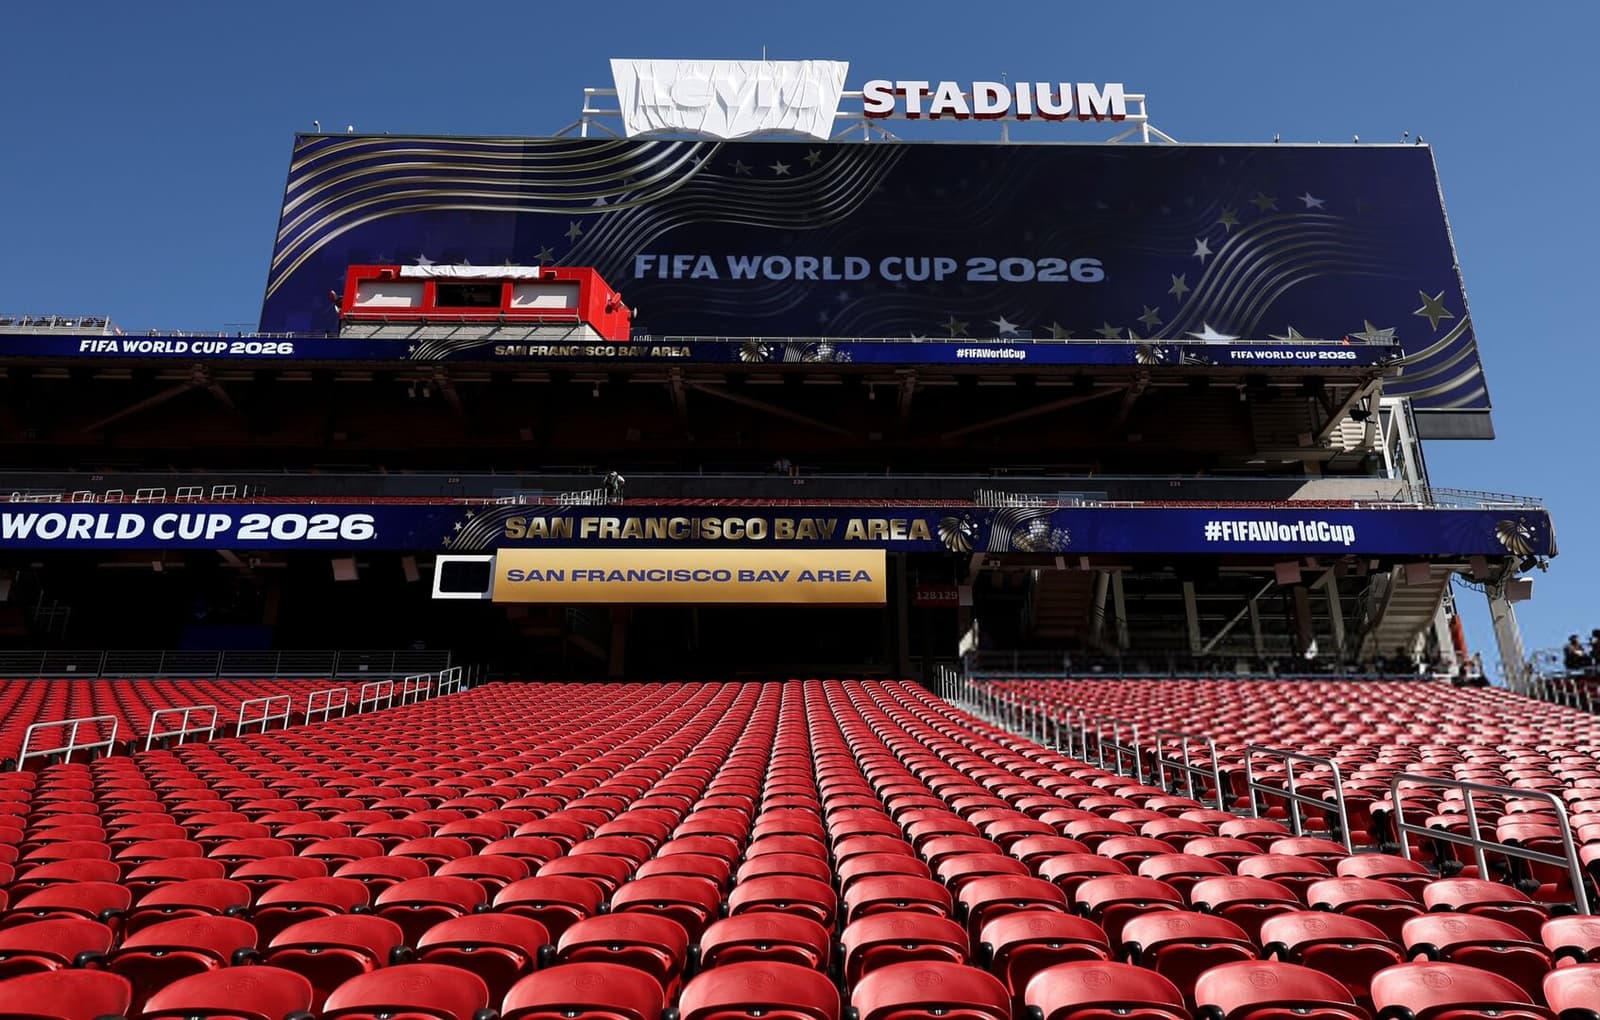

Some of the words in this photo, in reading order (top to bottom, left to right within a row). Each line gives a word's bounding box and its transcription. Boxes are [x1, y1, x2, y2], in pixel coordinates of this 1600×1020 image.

[863, 80, 1127, 120] STADIUM
[634, 254, 719, 278] FIFA
[726, 255, 870, 280] WORLD
[879, 257, 957, 281] CUP
[966, 257, 1105, 282] 2026
[79, 339, 119, 353] FIFA
[122, 340, 189, 354] WORLD
[191, 341, 228, 354] CUP
[229, 341, 294, 355] 2026
[494, 345, 528, 357] SAN
[528, 345, 616, 357] FRANCISCO
[617, 345, 648, 357] BAY
[650, 346, 691, 358] AREA
[956, 348, 1026, 361] #FIFAWorldCup
[1230, 350, 1255, 360] FIFA
[1255, 350, 1294, 360] WORLD
[1295, 351, 1317, 360] CUP
[1318, 351, 1357, 361] 2026
[1, 512, 146, 540] WORLD
[152, 513, 232, 540] CUP
[236, 513, 374, 541] 2026
[504, 516, 574, 540] SAN
[580, 517, 768, 540] FRANCISCO
[774, 518, 838, 541] BAY
[844, 518, 932, 541] AREA
[1204, 520, 1356, 546] #FIFAWorldCup
[506, 569, 565, 583] SAN
[571, 569, 732, 583] FRANCISCO
[737, 569, 791, 583] BAY
[796, 569, 873, 583] AREA
[916, 591, 937, 601] 128
[937, 591, 958, 601] 129
